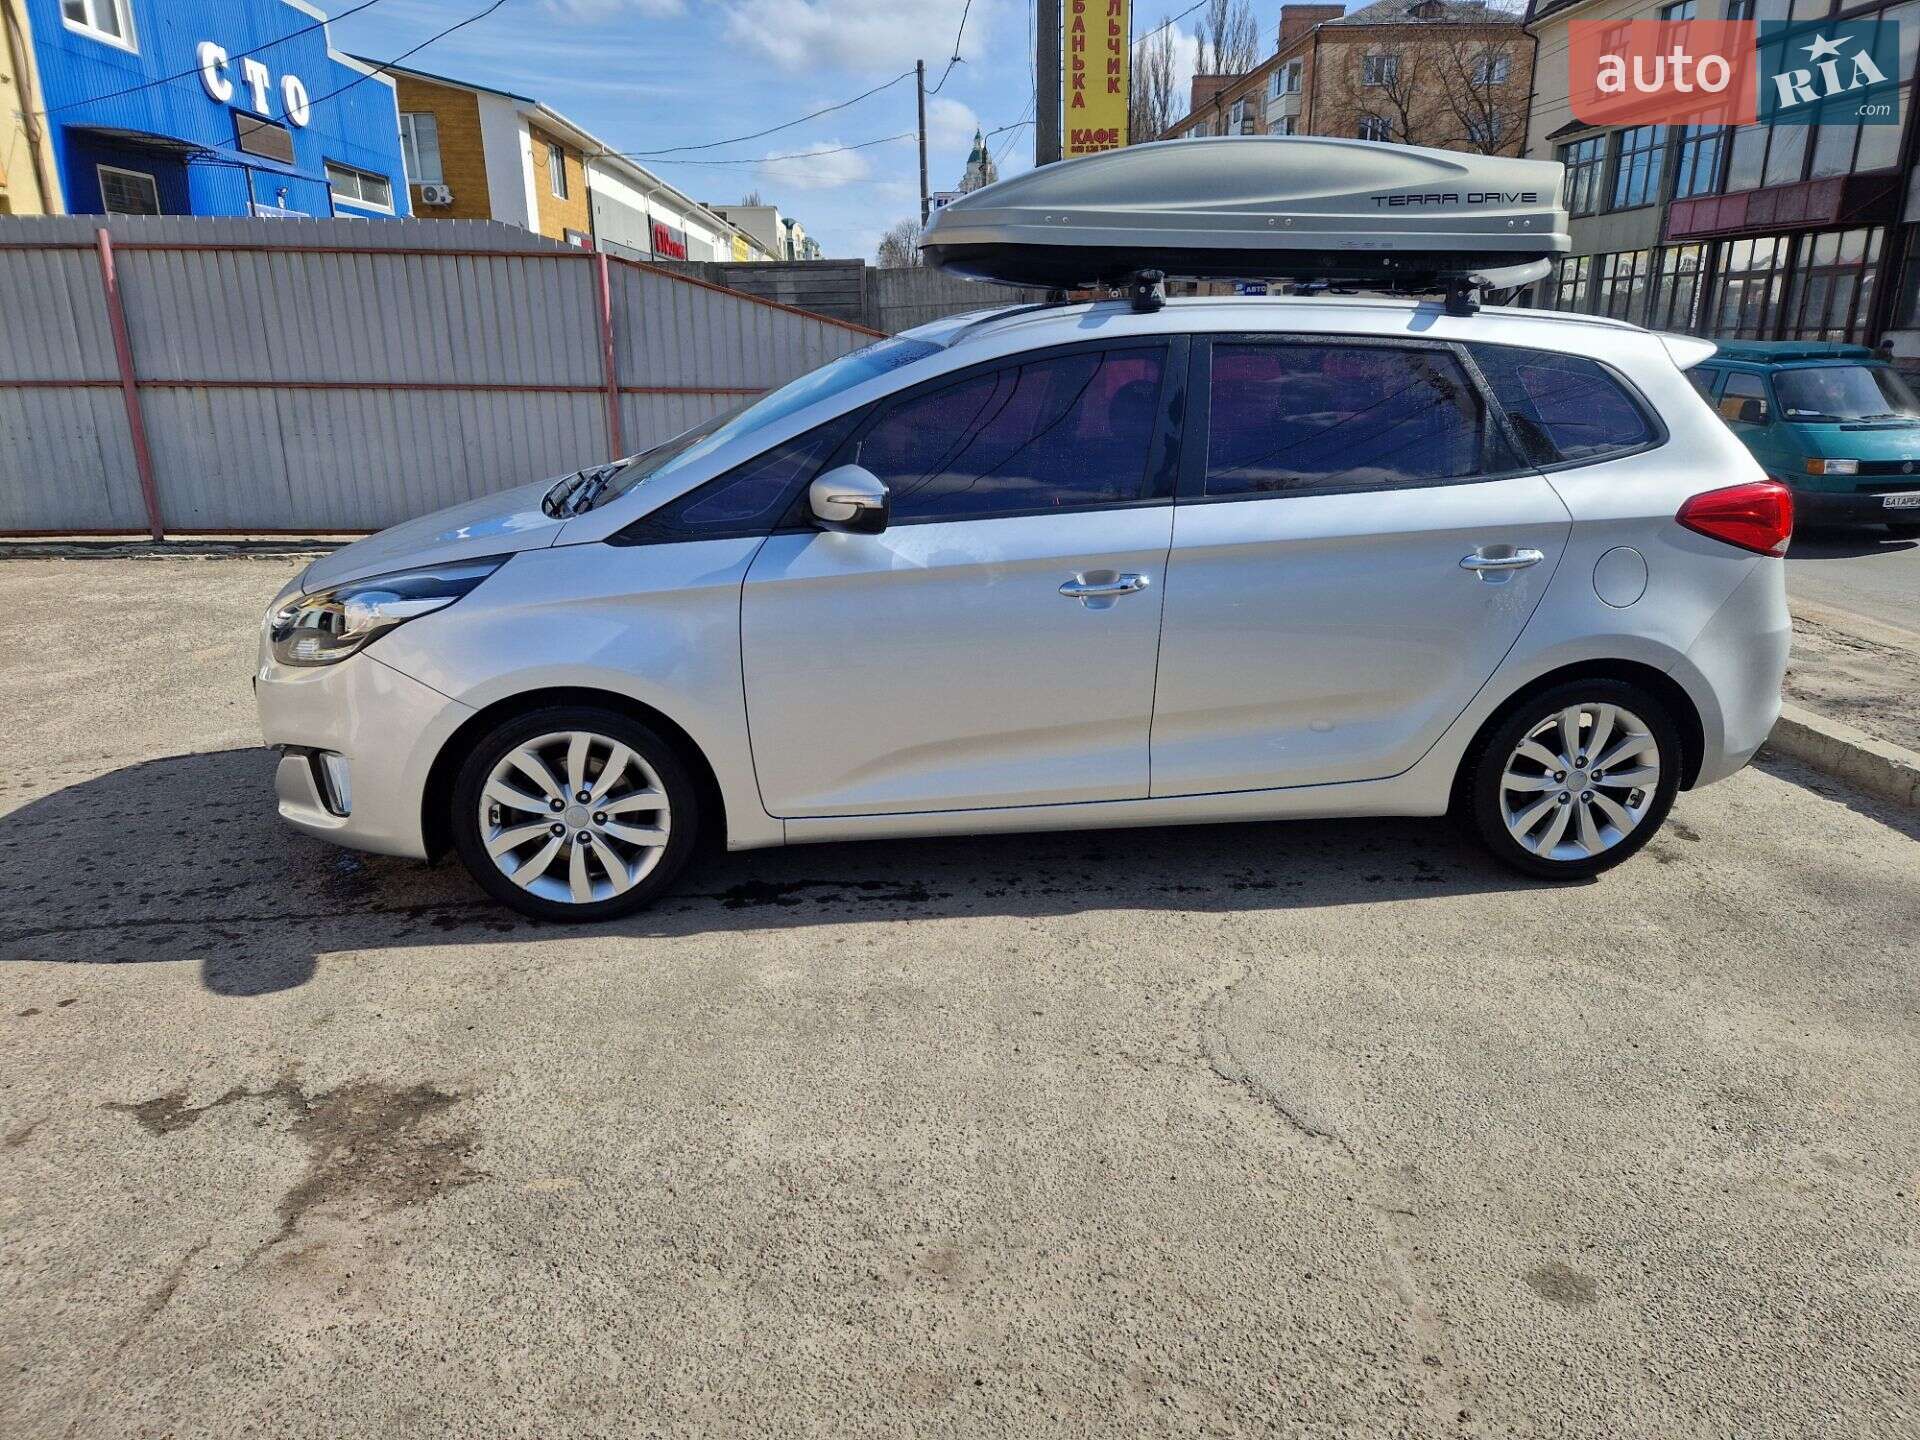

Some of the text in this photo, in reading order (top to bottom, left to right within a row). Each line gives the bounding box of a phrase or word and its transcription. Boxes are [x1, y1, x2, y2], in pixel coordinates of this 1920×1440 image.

[1072, 0, 1086, 108] БАНЬКА
[196, 41, 311, 128] СТО
[1071, 128, 1119, 144] КАФЕ
[1370, 192, 1537, 207] TERRA DRIVE
